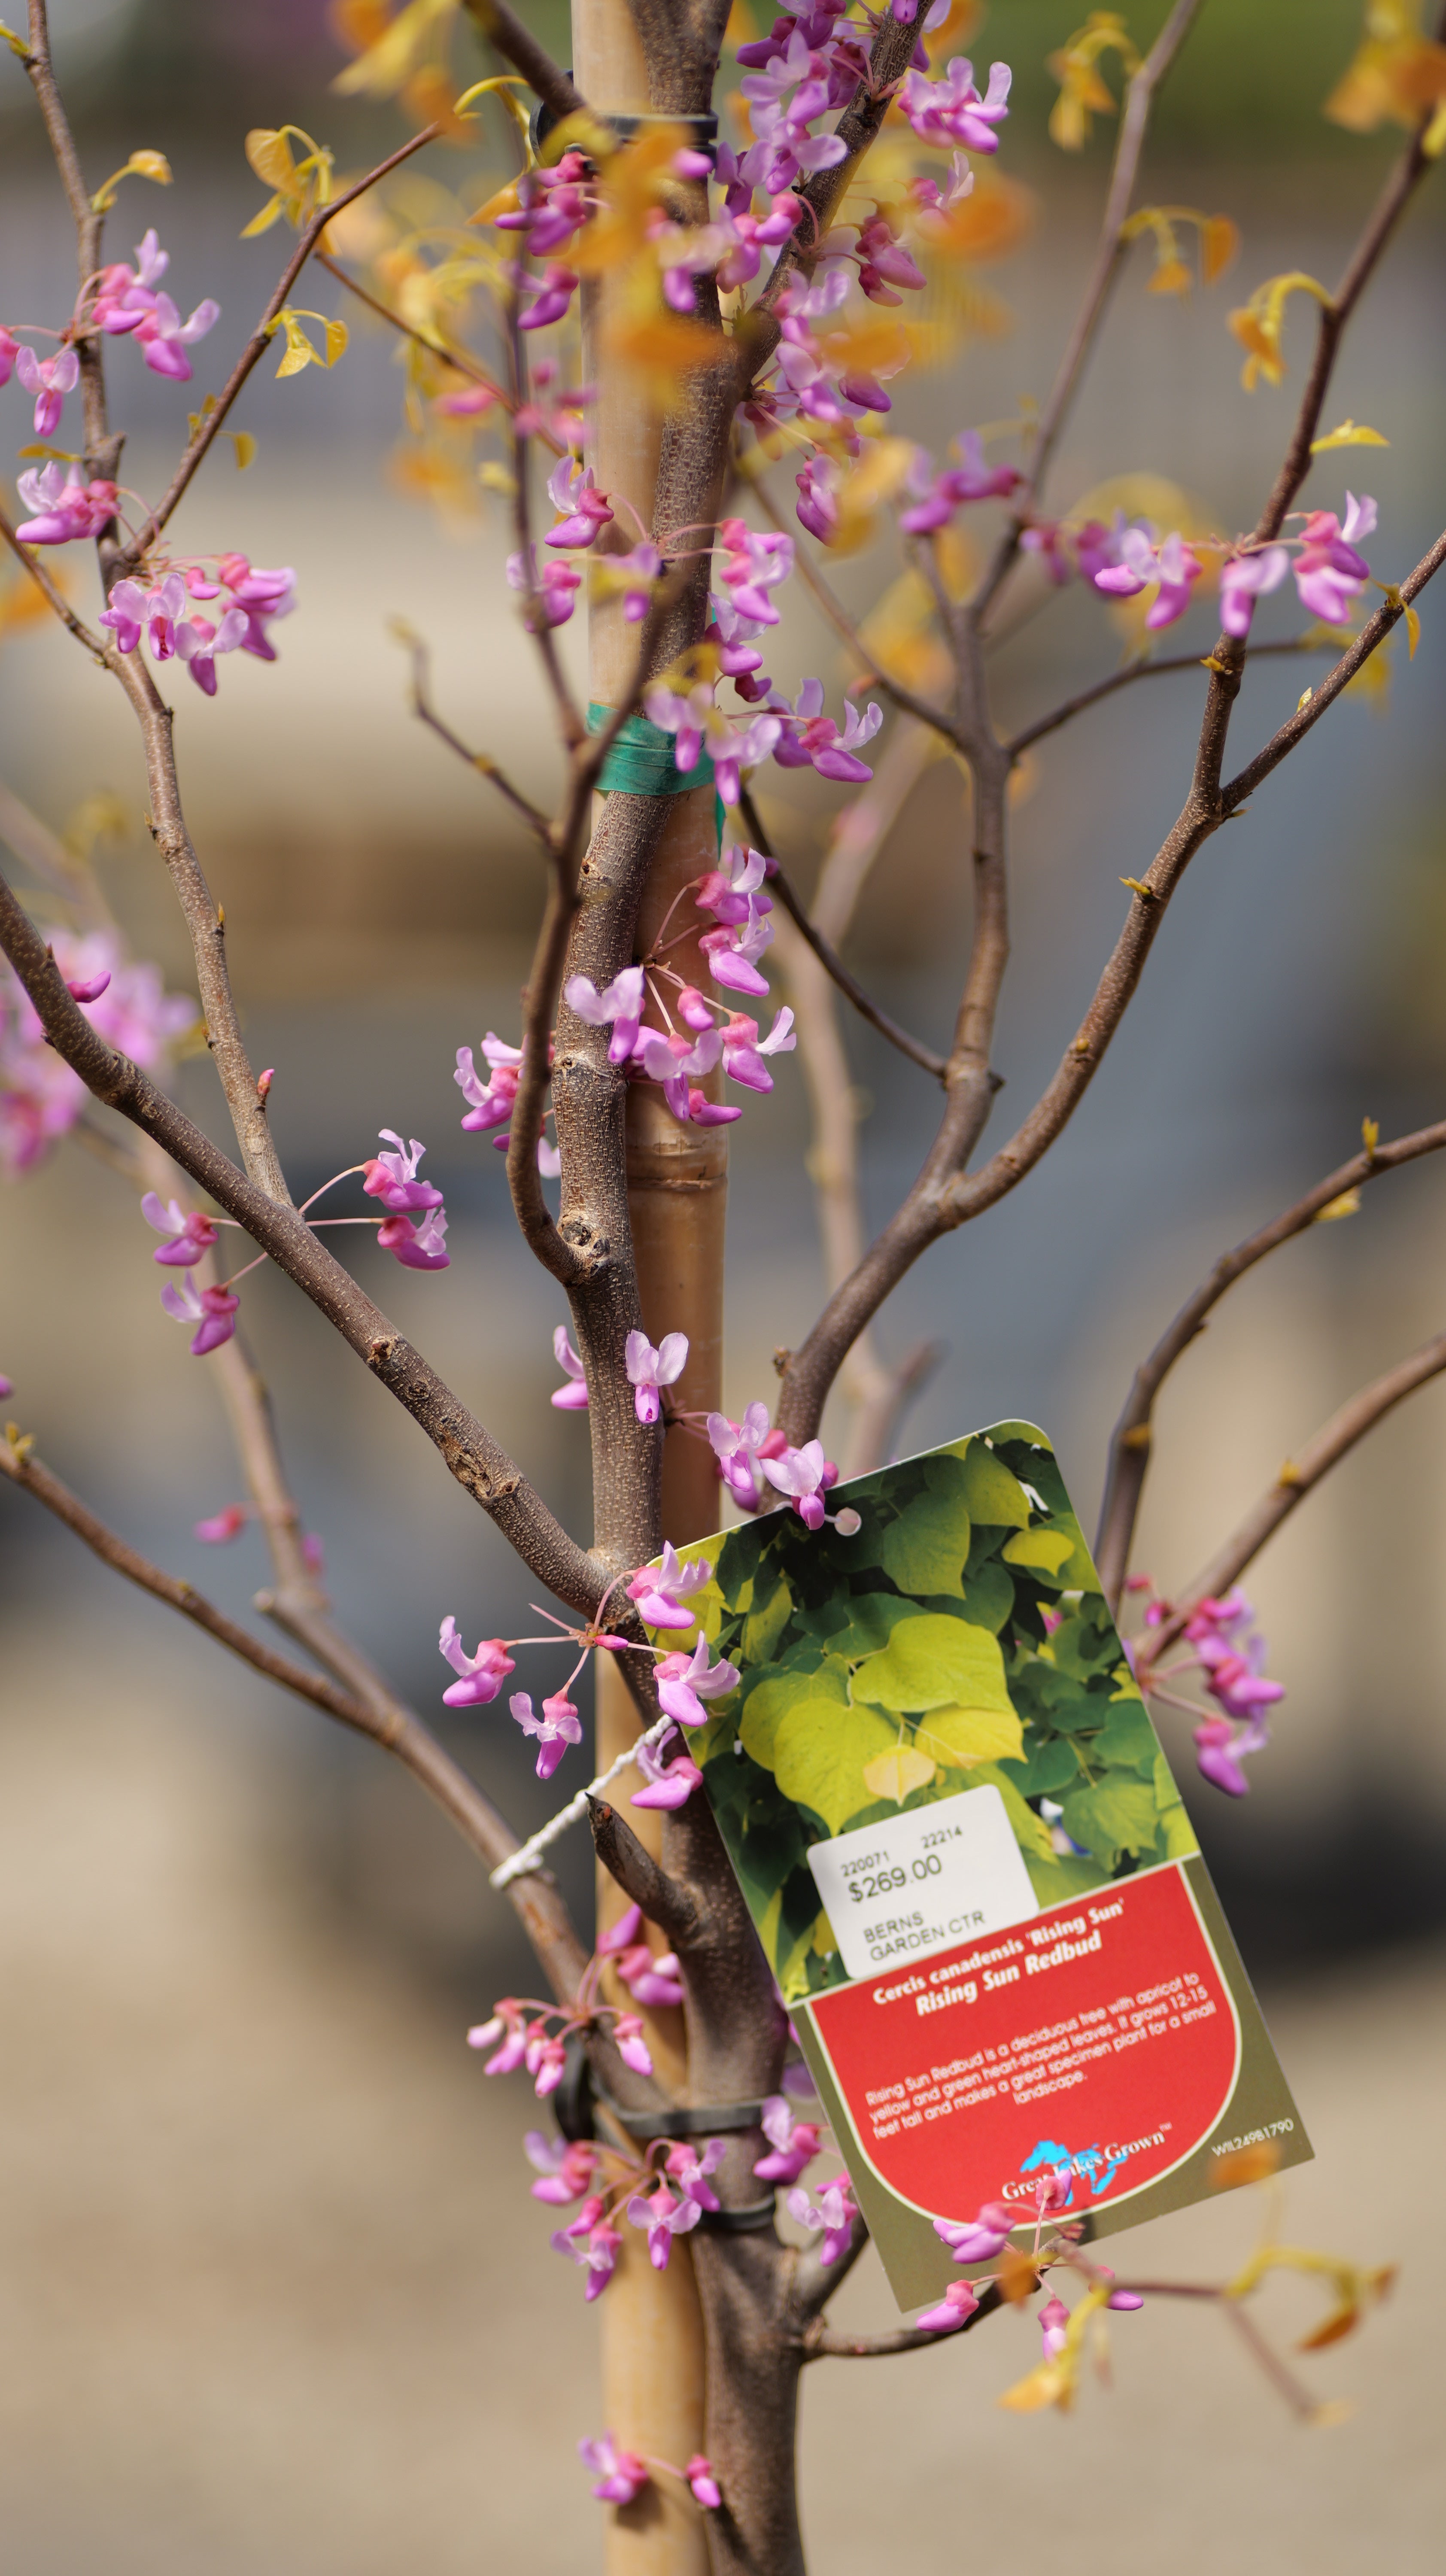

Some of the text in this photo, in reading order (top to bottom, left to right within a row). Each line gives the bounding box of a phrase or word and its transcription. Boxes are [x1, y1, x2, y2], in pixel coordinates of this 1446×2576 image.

[840, 1826, 963, 1877] 220071 22214
[848, 1854, 942, 1903] $269.00
[863, 1912, 924, 1943] BERNS
[870, 1911, 985, 1961] GARDEN CTR
[872, 1896, 1124, 2005] Cercis canadensis 'Rising Sun'
[915, 1929, 1102, 2017] Rising Sun Redbud
[866, 1973, 1199, 2105] Rising Sun Redbud is a deciduous tree with apricot to
[869, 1985, 1208, 2125] yellow and green heart-shaped leaves. It grows 12-15
[873, 1999, 1216, 2140] feet tall and makes a great specimen plant for a small
[1013, 2070, 1087, 2105] landscape.
